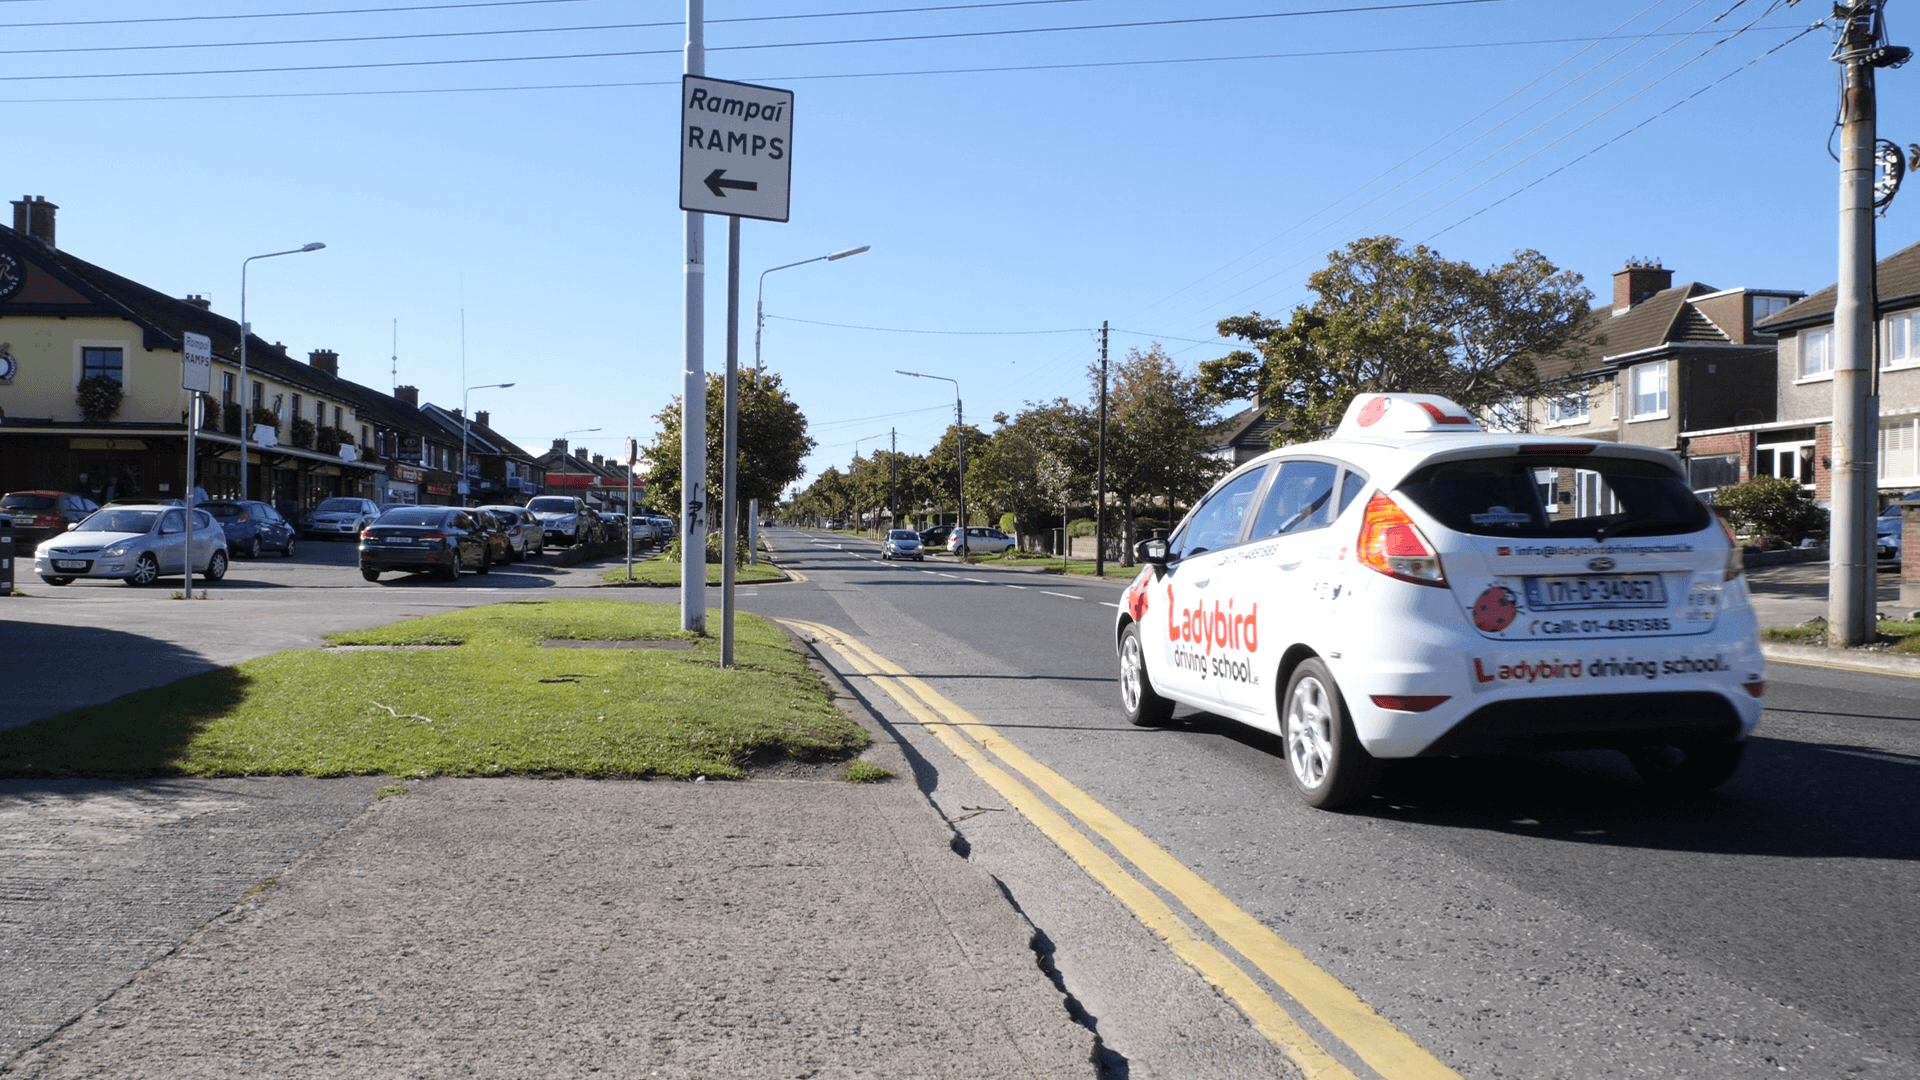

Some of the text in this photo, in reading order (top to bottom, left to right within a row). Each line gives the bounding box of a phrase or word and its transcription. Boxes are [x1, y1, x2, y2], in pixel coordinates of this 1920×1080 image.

[689, 88, 787, 122] Rampaí
[688, 125, 784, 160] RAMPS
[185, 352, 210, 367] RAMPS
[1167, 583, 1258, 656] Ladybird
[1174, 644, 1208, 680] driving
[1473, 657, 1582, 684] Ladybird
[1588, 656, 1657, 679] driving
